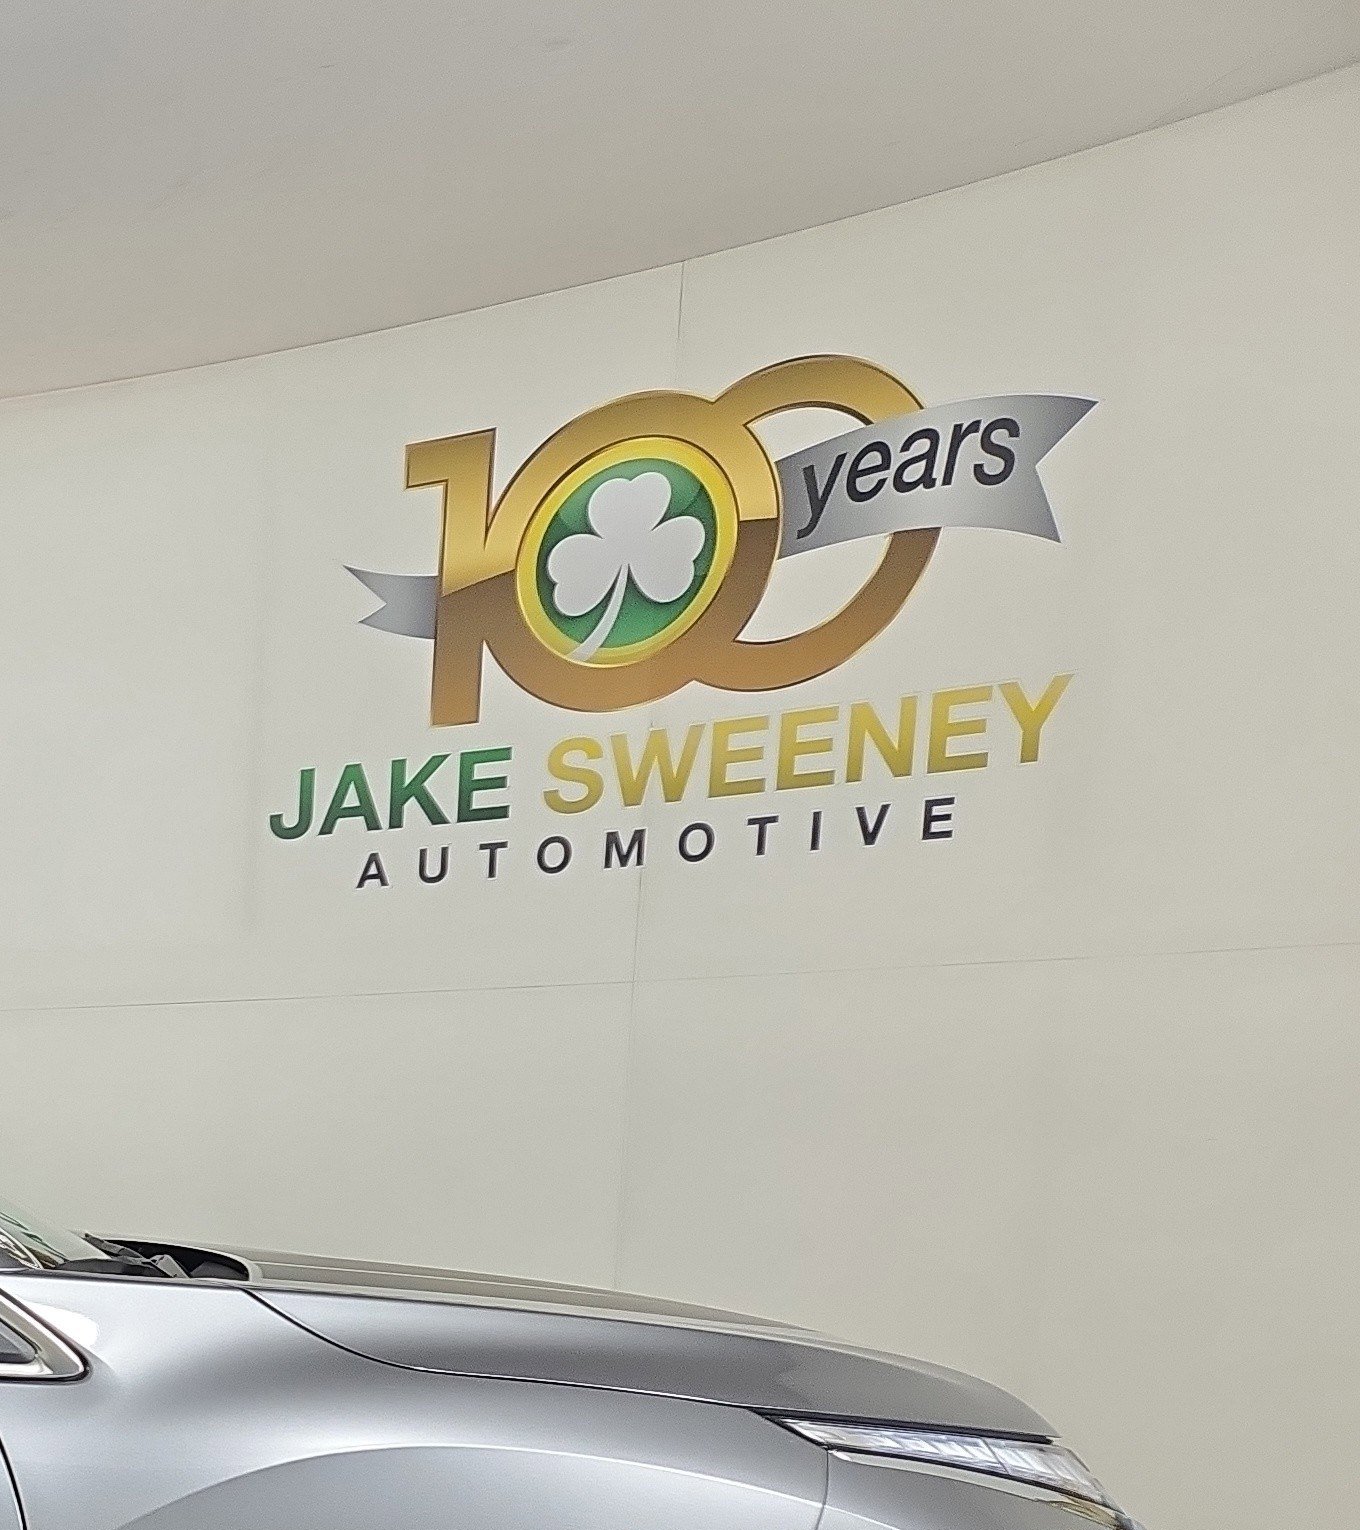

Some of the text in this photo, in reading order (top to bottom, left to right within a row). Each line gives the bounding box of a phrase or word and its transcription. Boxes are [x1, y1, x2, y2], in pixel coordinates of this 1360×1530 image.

[795, 416, 1021, 540] years
[269, 673, 1074, 840] JAKE SWEENEY
[355, 796, 957, 890] AUTOMOTIVE
